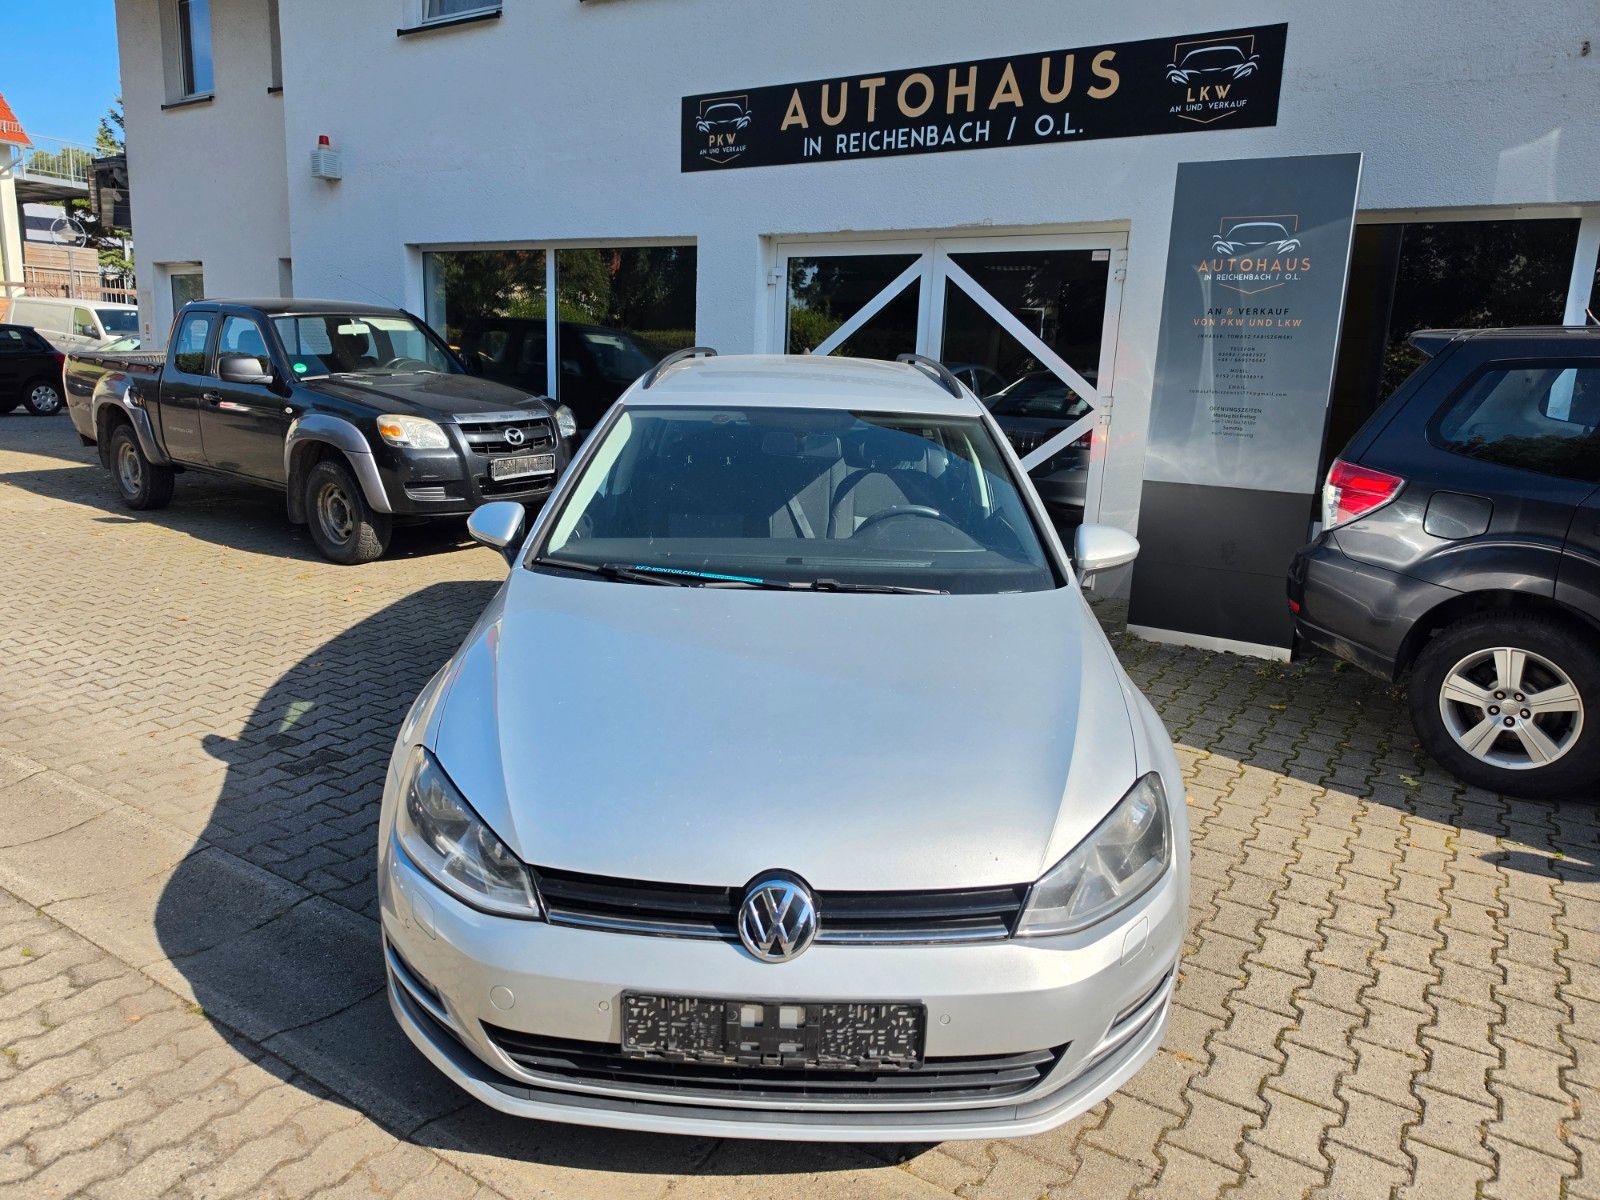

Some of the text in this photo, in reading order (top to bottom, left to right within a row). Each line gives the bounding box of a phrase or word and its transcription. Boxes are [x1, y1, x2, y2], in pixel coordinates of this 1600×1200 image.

[780, 50, 1120, 131] AUTOHAUS
[1186, 84, 1231, 103] LKW
[1169, 99, 1248, 113] AN UND VERKAUF
[709, 133, 737, 146] PKW
[803, 113, 1084, 157] IN REICHENBACH / O.L.
[709, 147, 720, 155] UND
[723, 145, 747, 153] VERKAUF
[1198, 257, 1312, 273] AUTOHAUS
[1204, 273, 1212, 281] IN
[1216, 273, 1272, 281] REICHENBACH
[1285, 273, 1301, 281] O.L.
[1207, 307, 1290, 316] AN & VERKAUF
[1193, 318, 1303, 328] VON PKW UND LKW
